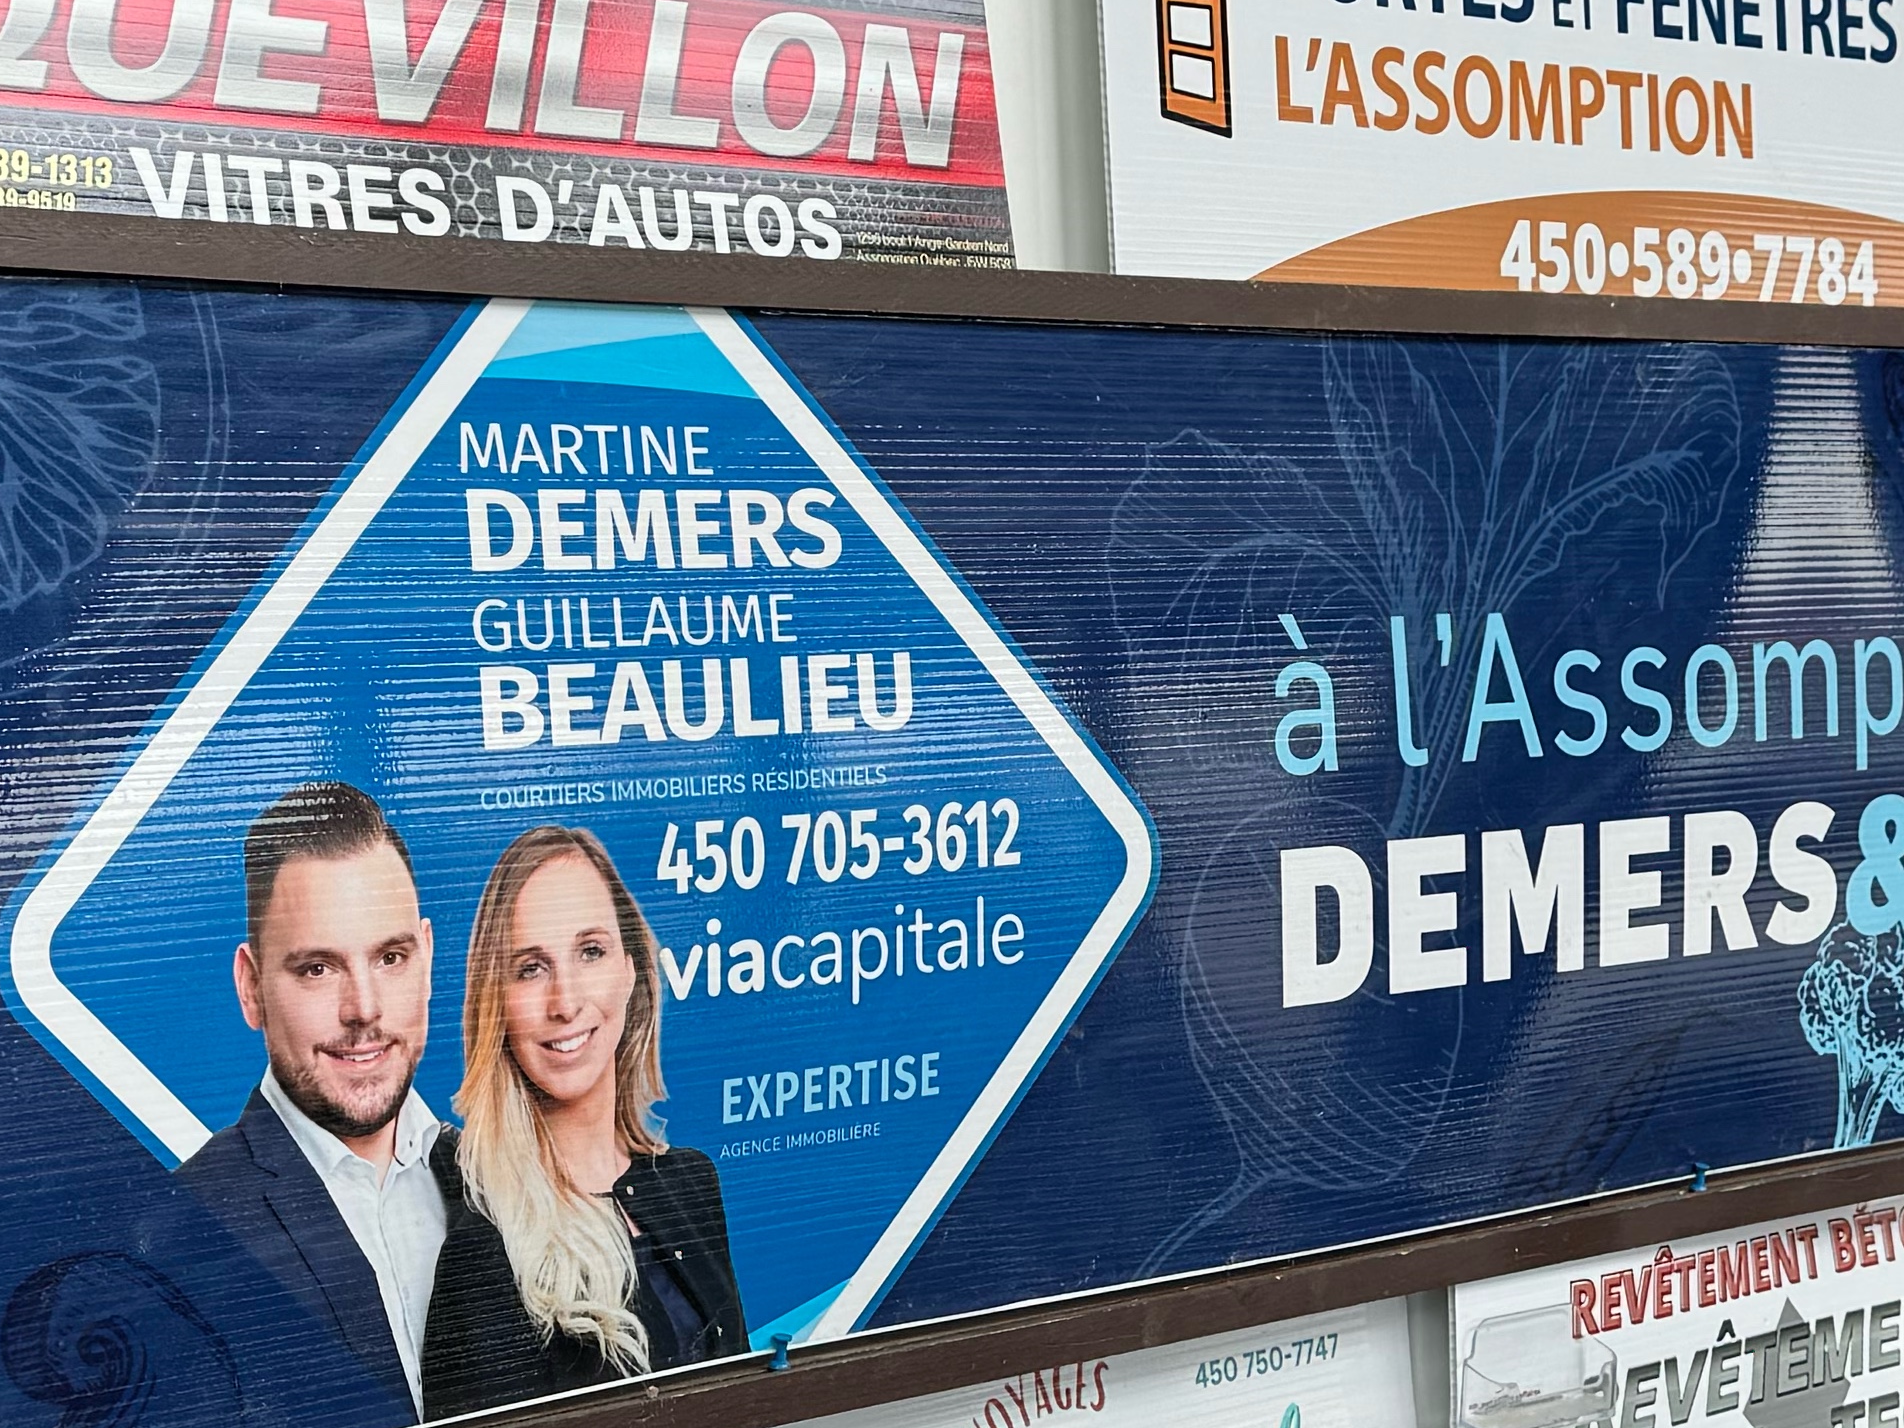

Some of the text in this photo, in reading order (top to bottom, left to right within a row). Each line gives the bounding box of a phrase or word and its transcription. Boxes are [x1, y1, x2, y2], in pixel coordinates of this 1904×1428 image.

[1276, 36, 1754, 160] L'ASSOMPTION
[128, 145, 844, 261] VITRES D'AUTOS
[459, 422, 714, 476] MARTINE
[466, 487, 843, 572] DEMERS
[472, 595, 797, 652] GUILLAUME
[478, 652, 913, 751] BEAULIEU
[1273, 613, 1338, 776] à
[480, 764, 887, 810] COURTIERS IMMOBILIERS RÉSIDENTIELS
[657, 798, 1022, 895] 450 705-3612
[659, 896, 1026, 1005] viacapitale
[722, 1052, 942, 1125] EXPERTISE
[719, 1122, 882, 1159] AGENCE IMMOBILIÈRE
[1570, 1225, 1819, 1339] REVÊTEMENT
[1195, 1333, 1338, 1390] 450 750-7747
